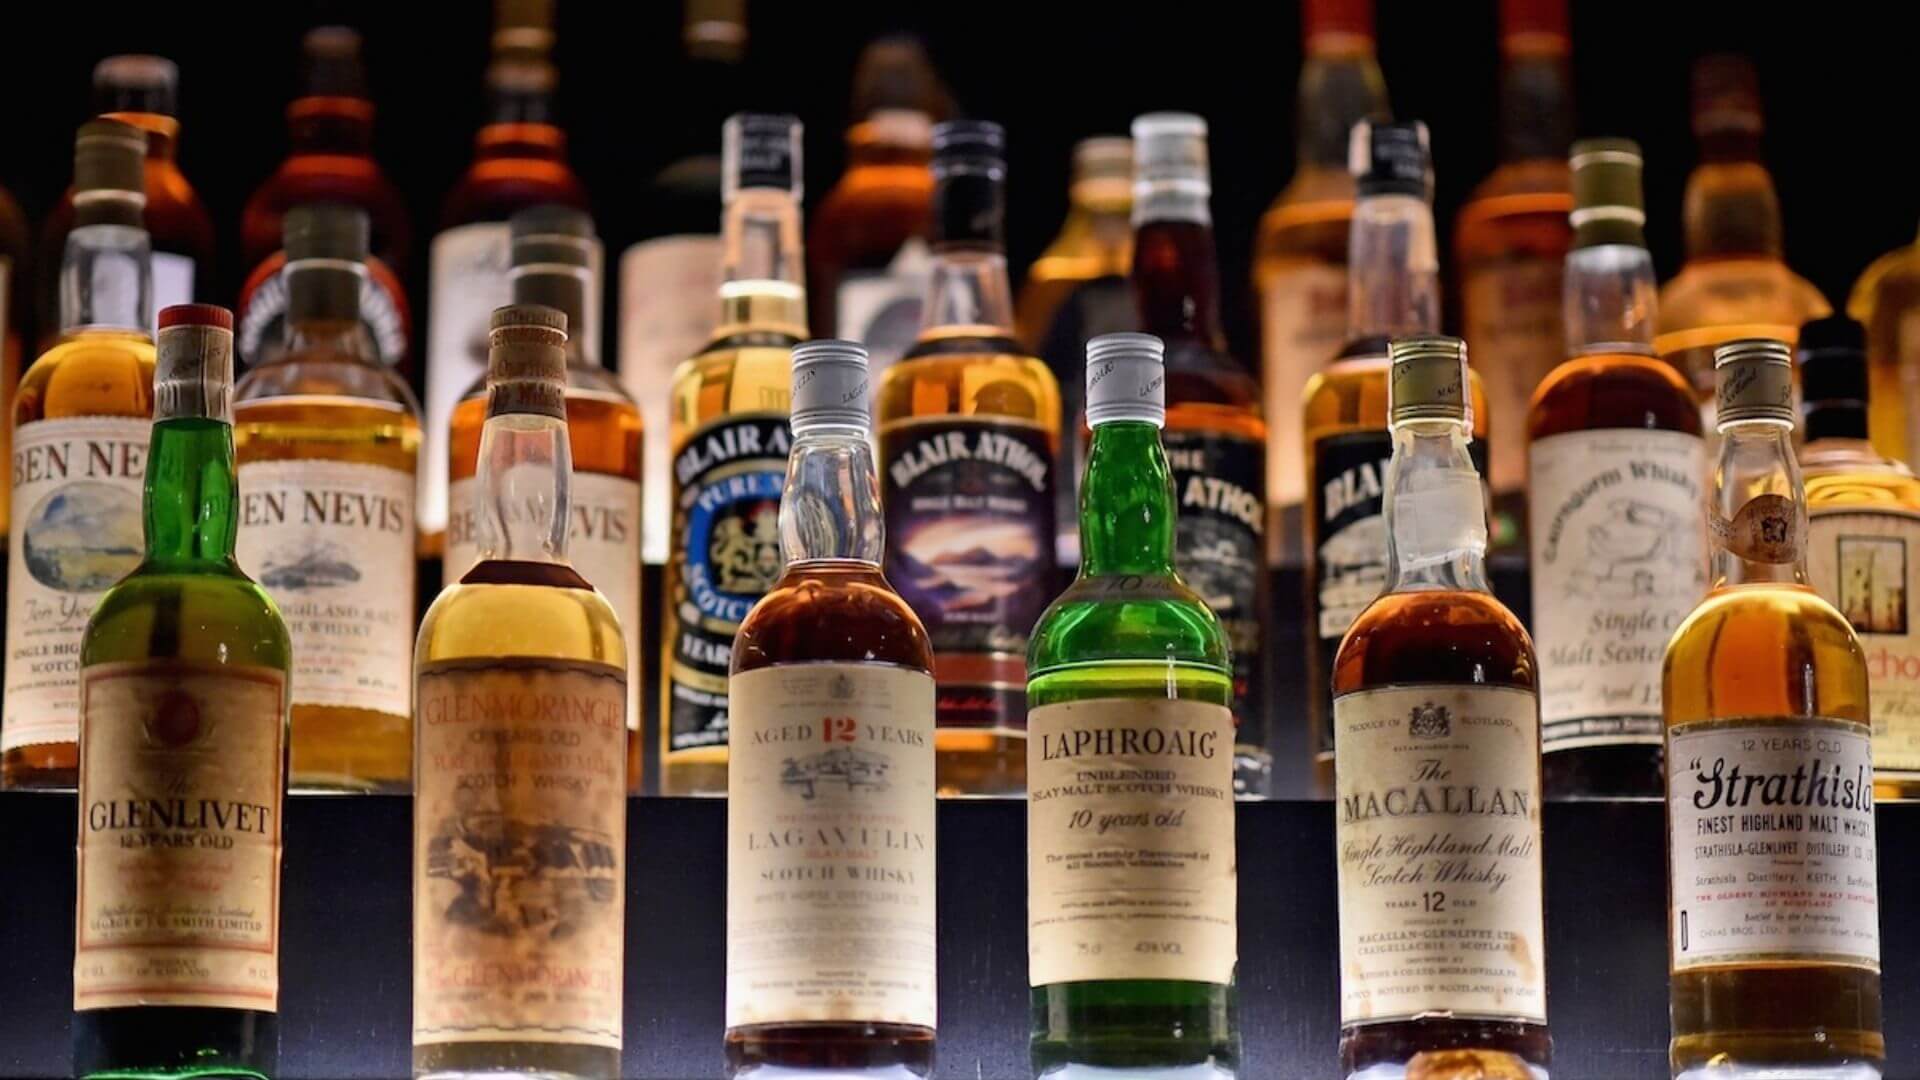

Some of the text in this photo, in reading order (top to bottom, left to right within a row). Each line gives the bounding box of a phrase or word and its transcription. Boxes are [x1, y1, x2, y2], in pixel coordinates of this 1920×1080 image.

[302, 490, 404, 533] NEVIS
[752, 725, 812, 746] AGED
[822, 717, 857, 743] 12
[865, 724, 925, 748] YEARS
[1741, 738, 1842, 753] 12 YEARS OLD
[1076, 769, 1177, 782] UNBLENDED
[1410, 759, 1451, 783] The
[1062, 783, 1104, 797] MALT
[1107, 782, 1171, 797] SCOTCH
[1175, 784, 1225, 801] WHISKY
[88, 799, 271, 835] GLENLIVET
[1344, 786, 1529, 825] MACALLAN
[1068, 809, 1186, 835] 10 years old
[1697, 816, 1734, 835] FINEST
[1741, 814, 1803, 832] HIGHLAND
[1809, 815, 1839, 834] MALT
[138, 833, 193, 849] YEARS
[199, 834, 234, 850] OLD
[748, 826, 926, 852] LAGAVULIN
[1389, 830, 1488, 863] Highland
[1494, 833, 1533, 859] Malt
[761, 866, 915, 885] SCOTCH WHISKY
[1362, 860, 1509, 893] Scotch Whisky
[1422, 891, 1446, 913] 12
